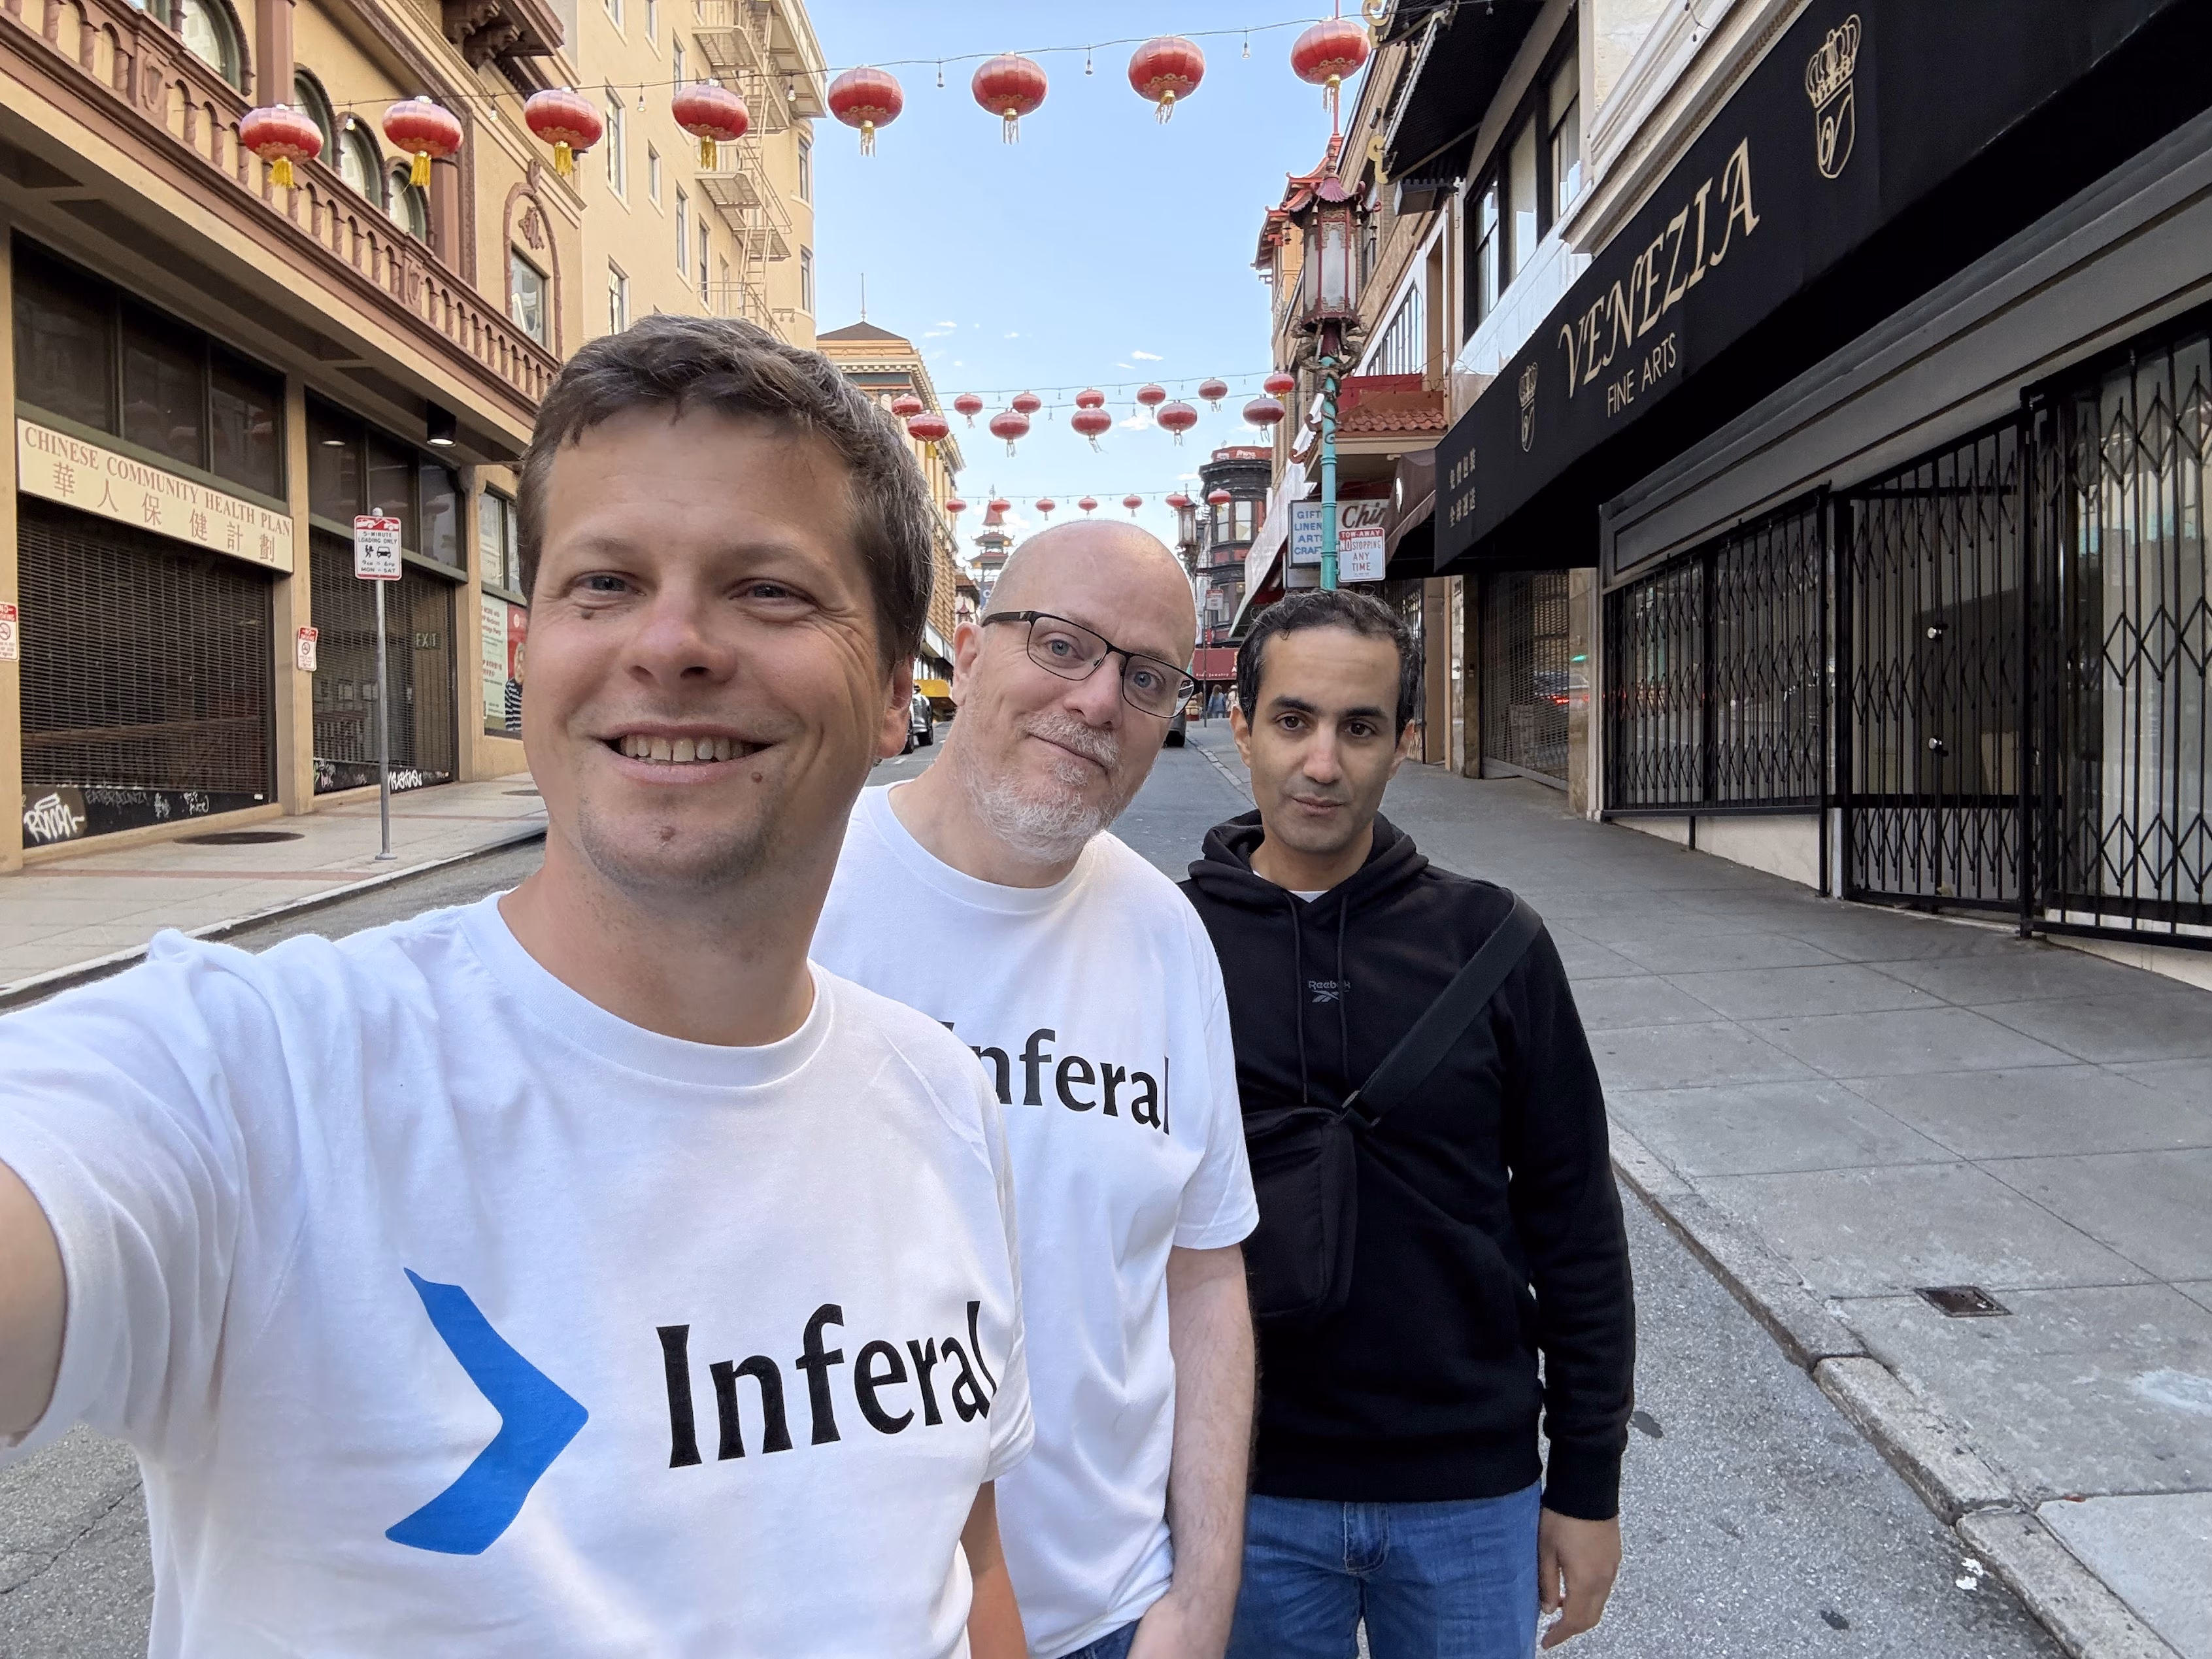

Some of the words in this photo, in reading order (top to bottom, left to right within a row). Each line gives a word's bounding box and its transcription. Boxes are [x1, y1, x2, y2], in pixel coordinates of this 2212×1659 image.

[1558, 136, 1760, 399] VENEZIA
[1607, 369, 1634, 418] FINE
[1641, 332, 1676, 392] ARTS
[25, 426, 99, 470] CHINESE
[107, 456, 198, 504] COMMUNITY
[205, 492, 255, 525] HEALTH
[261, 512, 290, 537] PLAN
[53, 461, 275, 563] 華人保健計劃
[1297, 511, 1322, 519] GIFT
[1341, 529, 1381, 538] TOW-AWAY
[1340, 539, 1350, 550] NO
[1352, 541, 1381, 550] STOPPING
[1294, 546, 1322, 555] CRAF
[1353, 552, 1370, 560] ANY
[1352, 563, 1371, 571] TIME
[1308, 980, 1350, 990] Reebk
[939, 1020, 1169, 1135] nferal
[656, 1301, 996, 1469] Inferal
